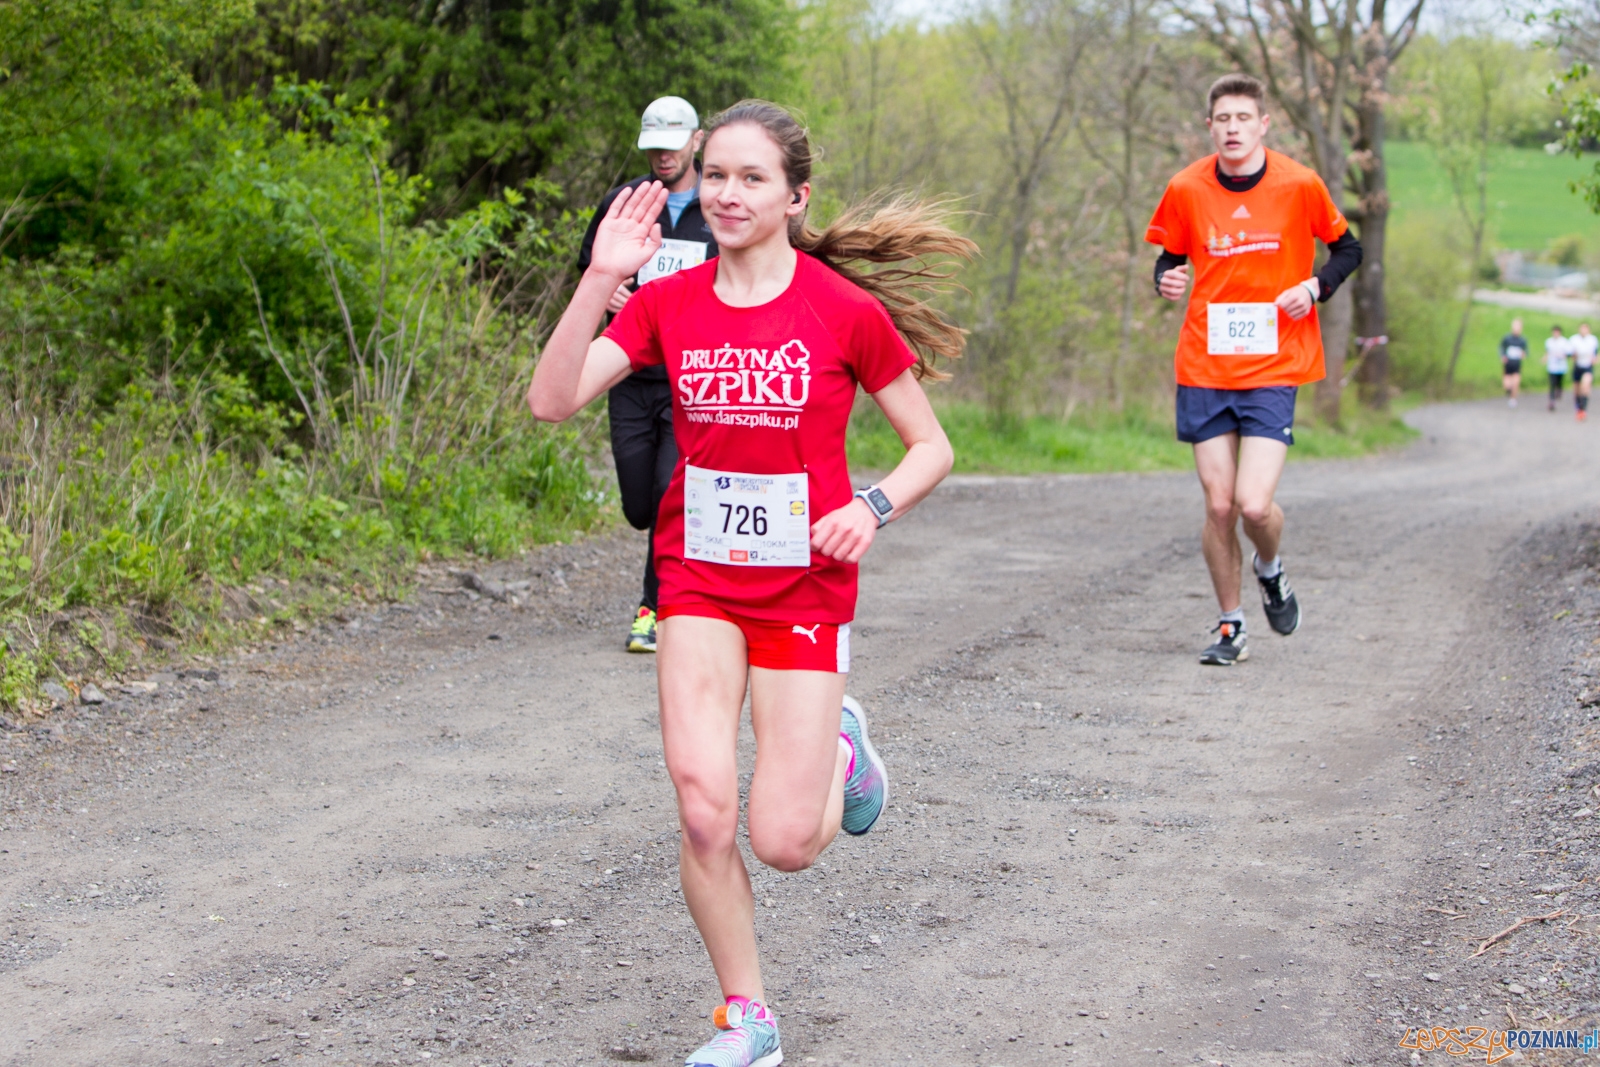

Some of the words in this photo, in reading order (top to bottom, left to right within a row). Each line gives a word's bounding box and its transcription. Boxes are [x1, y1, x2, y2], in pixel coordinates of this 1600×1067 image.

[658, 256, 683, 272] 674
[1229, 321, 1255, 338] 622
[680, 342, 786, 371] DRUŻYNA
[678, 370, 811, 407] SZPIKU
[686, 410, 799, 430] www.darszpiku.pl
[719, 503, 767, 536] 726
